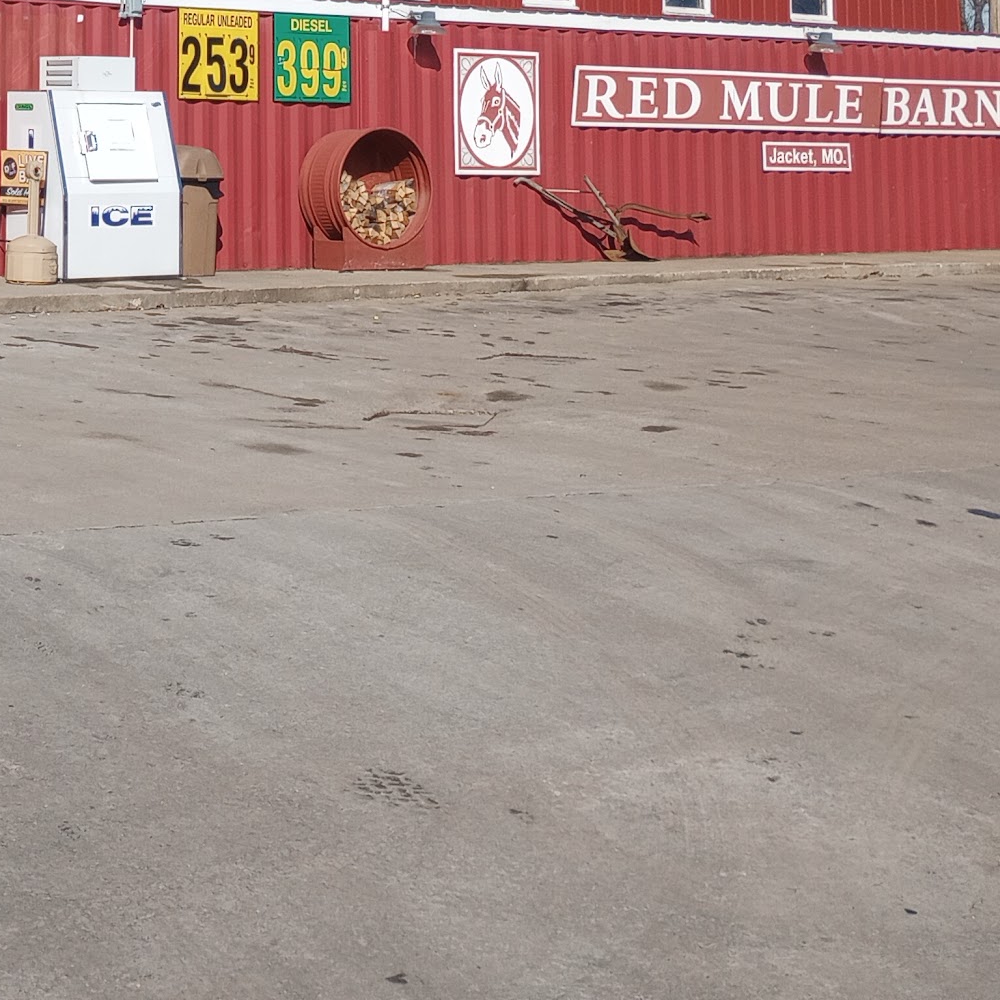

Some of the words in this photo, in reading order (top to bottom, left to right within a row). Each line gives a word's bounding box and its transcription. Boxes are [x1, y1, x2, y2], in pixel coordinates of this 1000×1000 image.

[183, 12, 215, 26] REGULAR
[217, 14, 252, 28] UNLEADED
[290, 18, 332, 33] DIESEL
[582, 75, 702, 119] RED
[719, 80, 863, 124] MULE
[881, 87, 1000, 127] BARN
[769, 147, 817, 166] Jacket,
[821, 148, 847, 164] MO.
[5, 187, 23, 196] Sold
[90, 205, 153, 227] ICE
